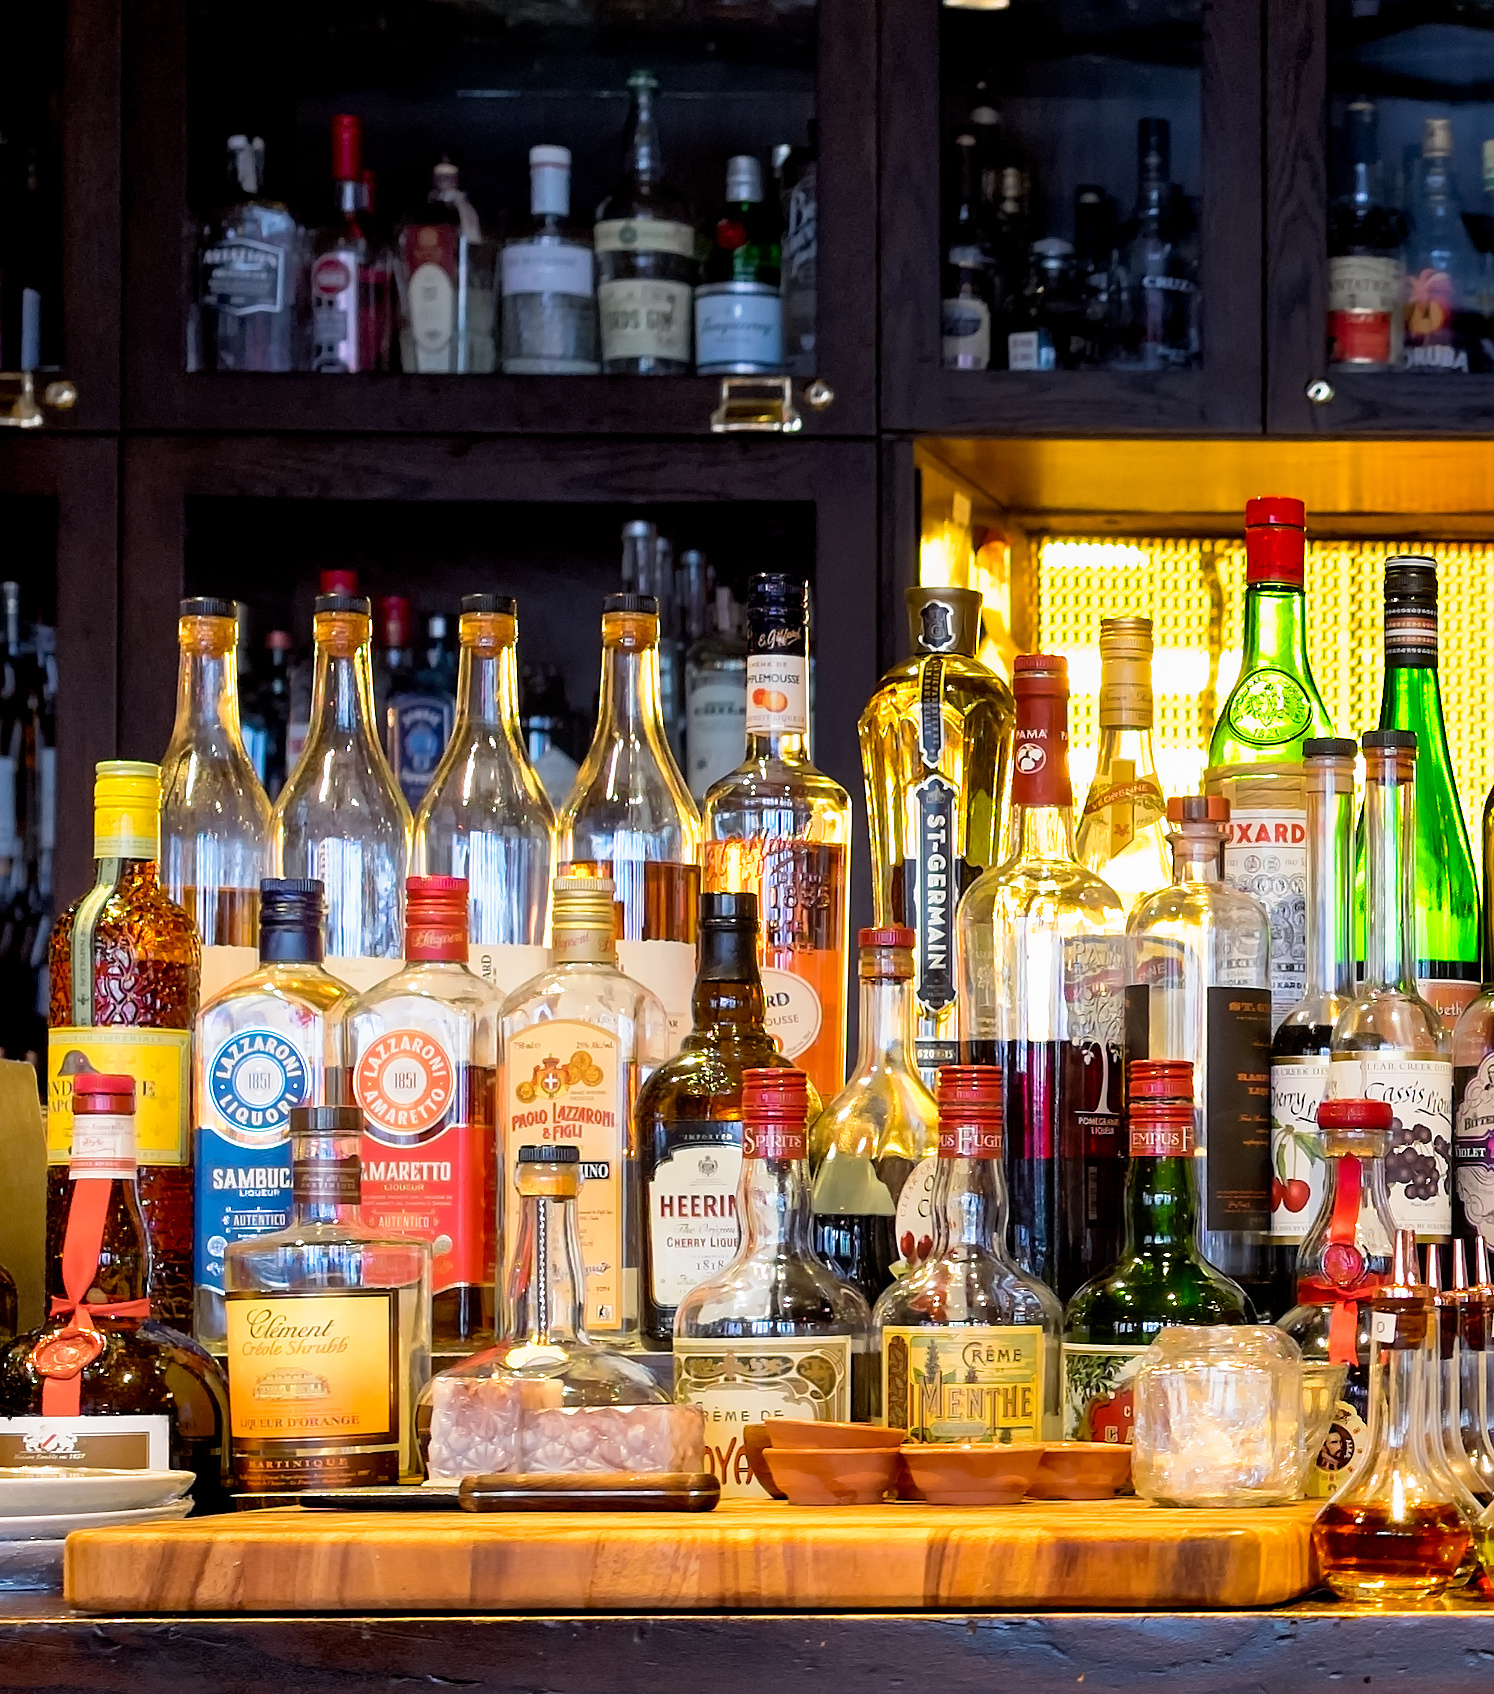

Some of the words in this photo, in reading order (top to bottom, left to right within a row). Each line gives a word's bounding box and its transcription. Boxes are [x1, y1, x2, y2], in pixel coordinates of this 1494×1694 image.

[1225, 822, 1306, 845] UXARD
[926, 812, 949, 971] ST-GERMAIN
[764, 1012, 800, 1027] OUSSE
[215, 1034, 302, 1080] LAZZARONI
[363, 1033, 447, 1078] LAZZARONI
[247, 1072, 272, 1091] 1851
[394, 1072, 418, 1091] 1851
[1364, 1080, 1427, 1105] Cassis
[218, 1092, 300, 1127] LIQUORI
[363, 1088, 447, 1126] AMARETTO
[512, 1110, 548, 1131] PAOLO
[553, 1102, 616, 1130] LAZZARONI
[553, 1124, 583, 1139] FIGLI
[742, 1126, 804, 1155] SPIRITS
[233, 1214, 286, 1228] AUTENTICO
[378, 1215, 430, 1229] AUTENTICO
[666, 1236, 707, 1249] CHERRY
[709, 1236, 738, 1248] LIQUE
[695, 1259, 725, 1272] 1818
[961, 1341, 1023, 1367] CRÈME
[919, 1373, 1034, 1444] MENTHE
[240, 1416, 283, 1430] LIQUEUR
[248, 1458, 348, 1469] MARTINIQUE
